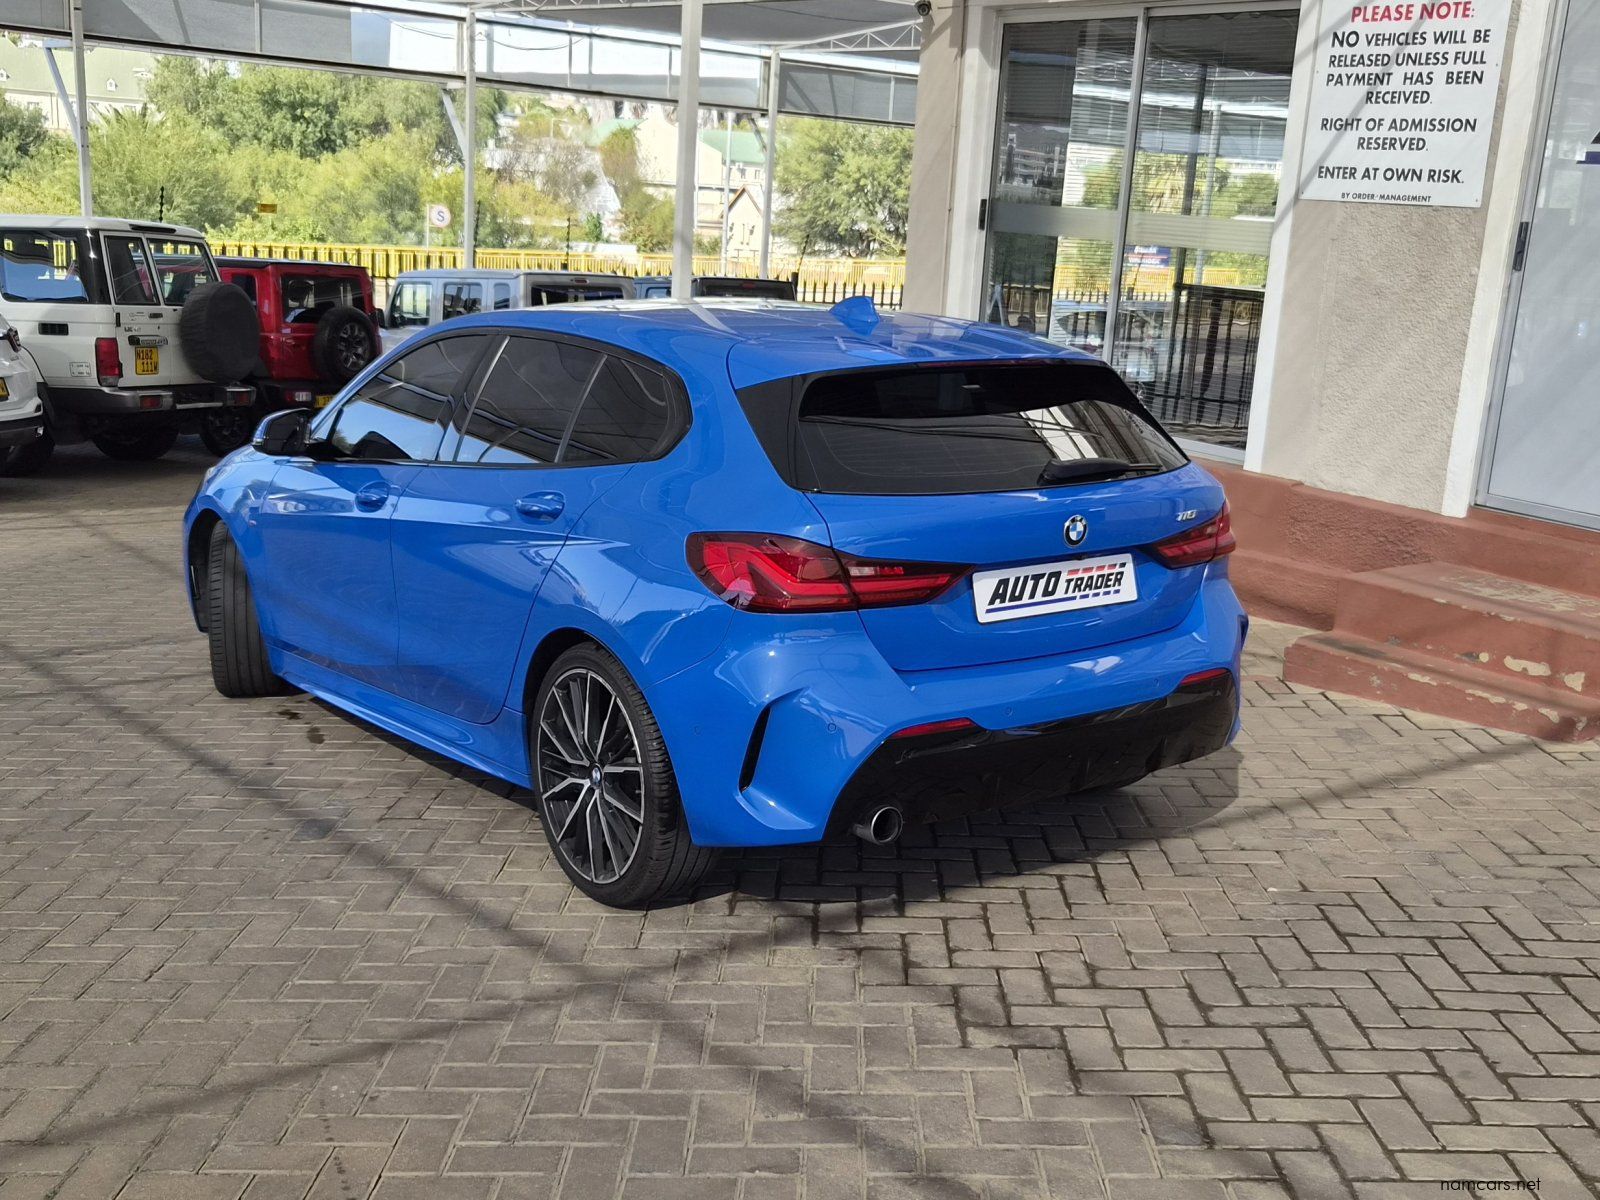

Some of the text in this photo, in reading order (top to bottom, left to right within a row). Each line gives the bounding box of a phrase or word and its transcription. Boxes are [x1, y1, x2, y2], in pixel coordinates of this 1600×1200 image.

[1351, 1, 1475, 22] PLEASE NOTE:
[1331, 29, 1491, 48] NO VEHICLES WILL BE
[1328, 51, 1487, 68] RELEASED UNLESS FULL
[1326, 70, 1484, 87] PAYMENT HAS BEEN
[1365, 90, 1432, 104] RECEIVED.
[1320, 118, 1477, 132] RIGHT OF ADMISSION
[1357, 137, 1429, 151] RESERVED.
[1317, 166, 1464, 184] ENTER AT OWN RISK.
[1341, 192, 1350, 200] BY
[1379, 194, 1431, 203] MANAGEMENT
[436, 210, 444, 222] S
[988, 571, 1124, 606] AUTO TRADER
